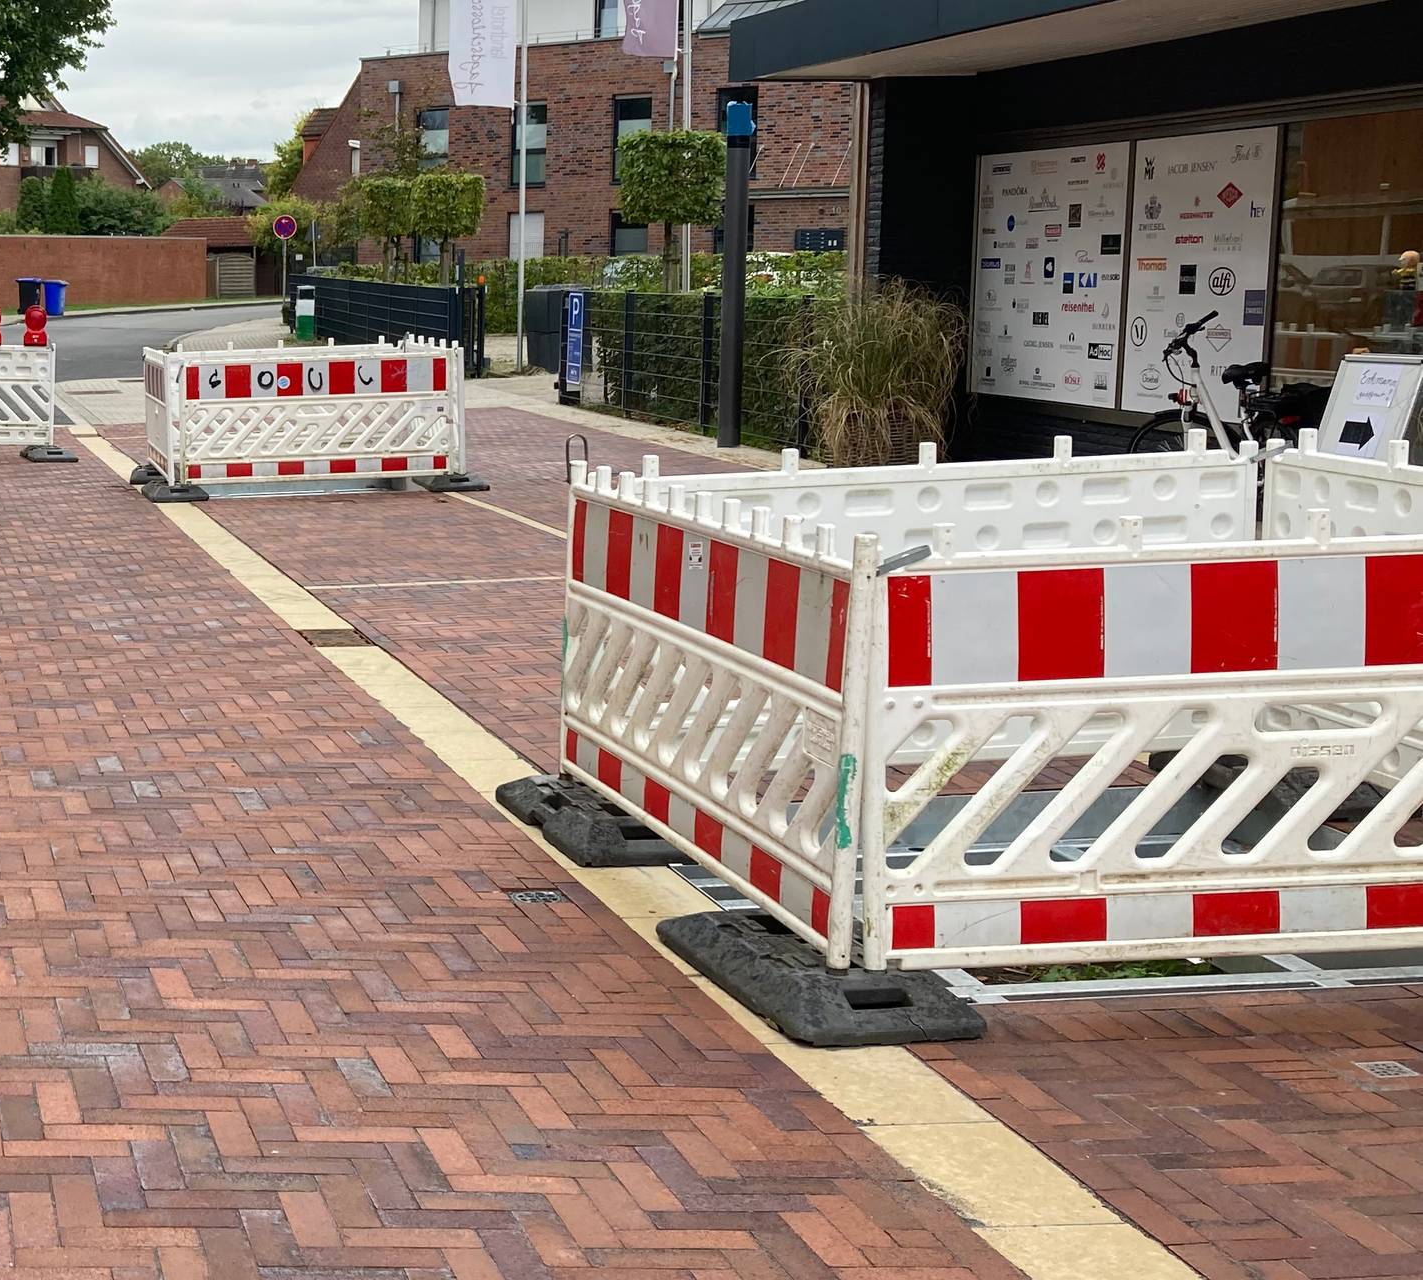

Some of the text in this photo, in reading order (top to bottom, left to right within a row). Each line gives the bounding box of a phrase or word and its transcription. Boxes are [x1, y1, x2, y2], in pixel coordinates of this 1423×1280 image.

[832, 206, 842, 214] 10
[1137, 258, 1167, 271] Thomas
[1212, 272, 1231, 294] alfi
[573, 298, 580, 325] P
[1061, 302, 1096, 313] reisenthel
